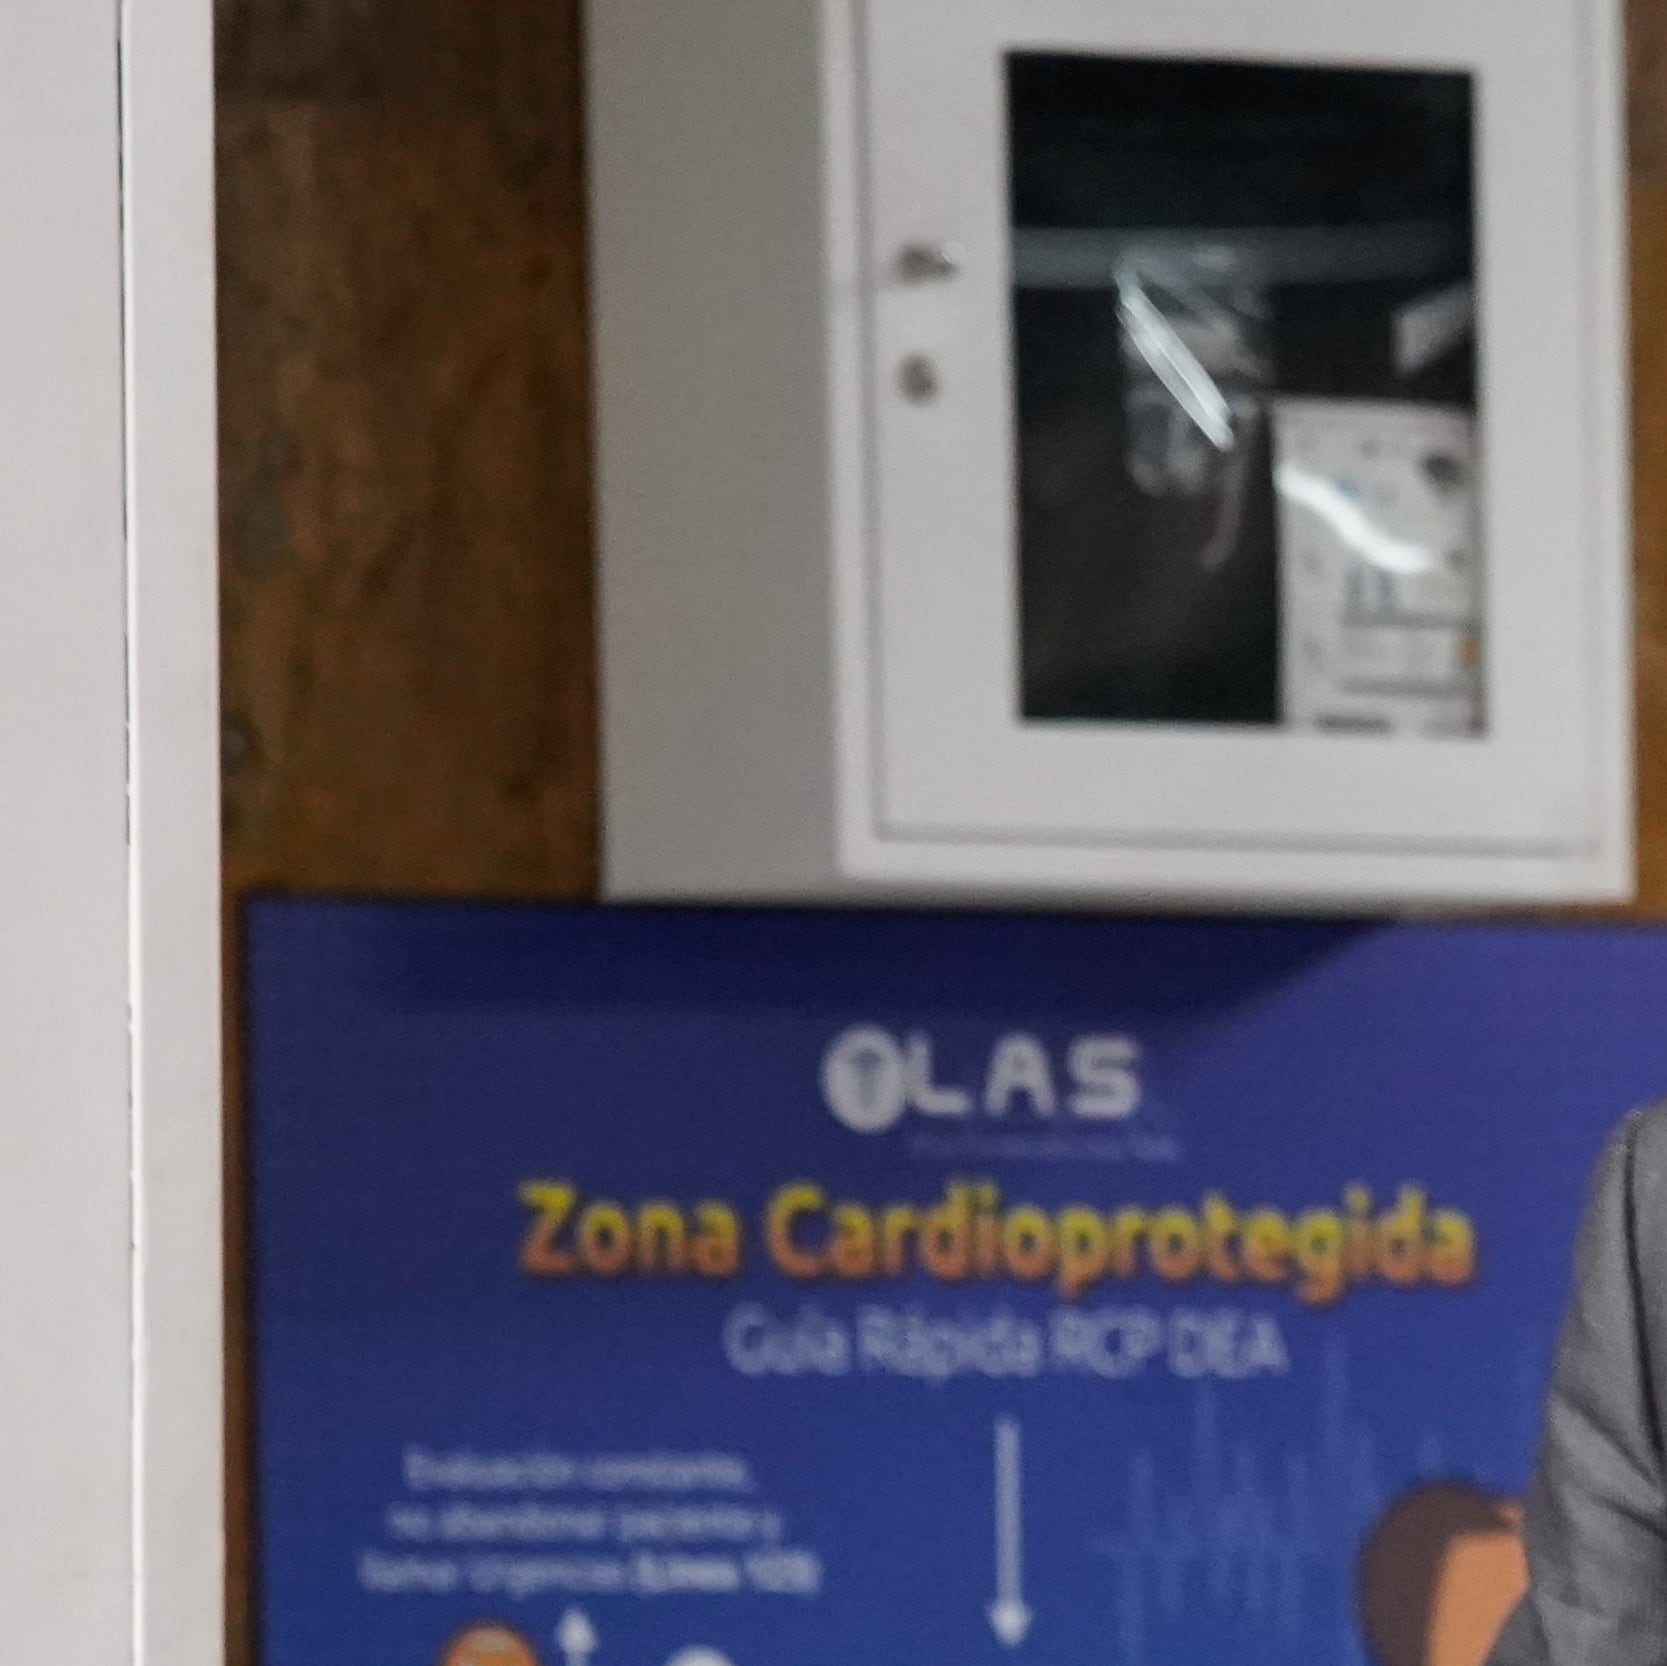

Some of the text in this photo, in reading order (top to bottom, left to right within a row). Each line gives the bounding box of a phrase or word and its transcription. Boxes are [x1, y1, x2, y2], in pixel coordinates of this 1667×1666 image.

[518, 1178, 1477, 1310] Zona Cardioprotegida
[722, 1302, 1290, 1386] Guía Rápida RCP DEA
